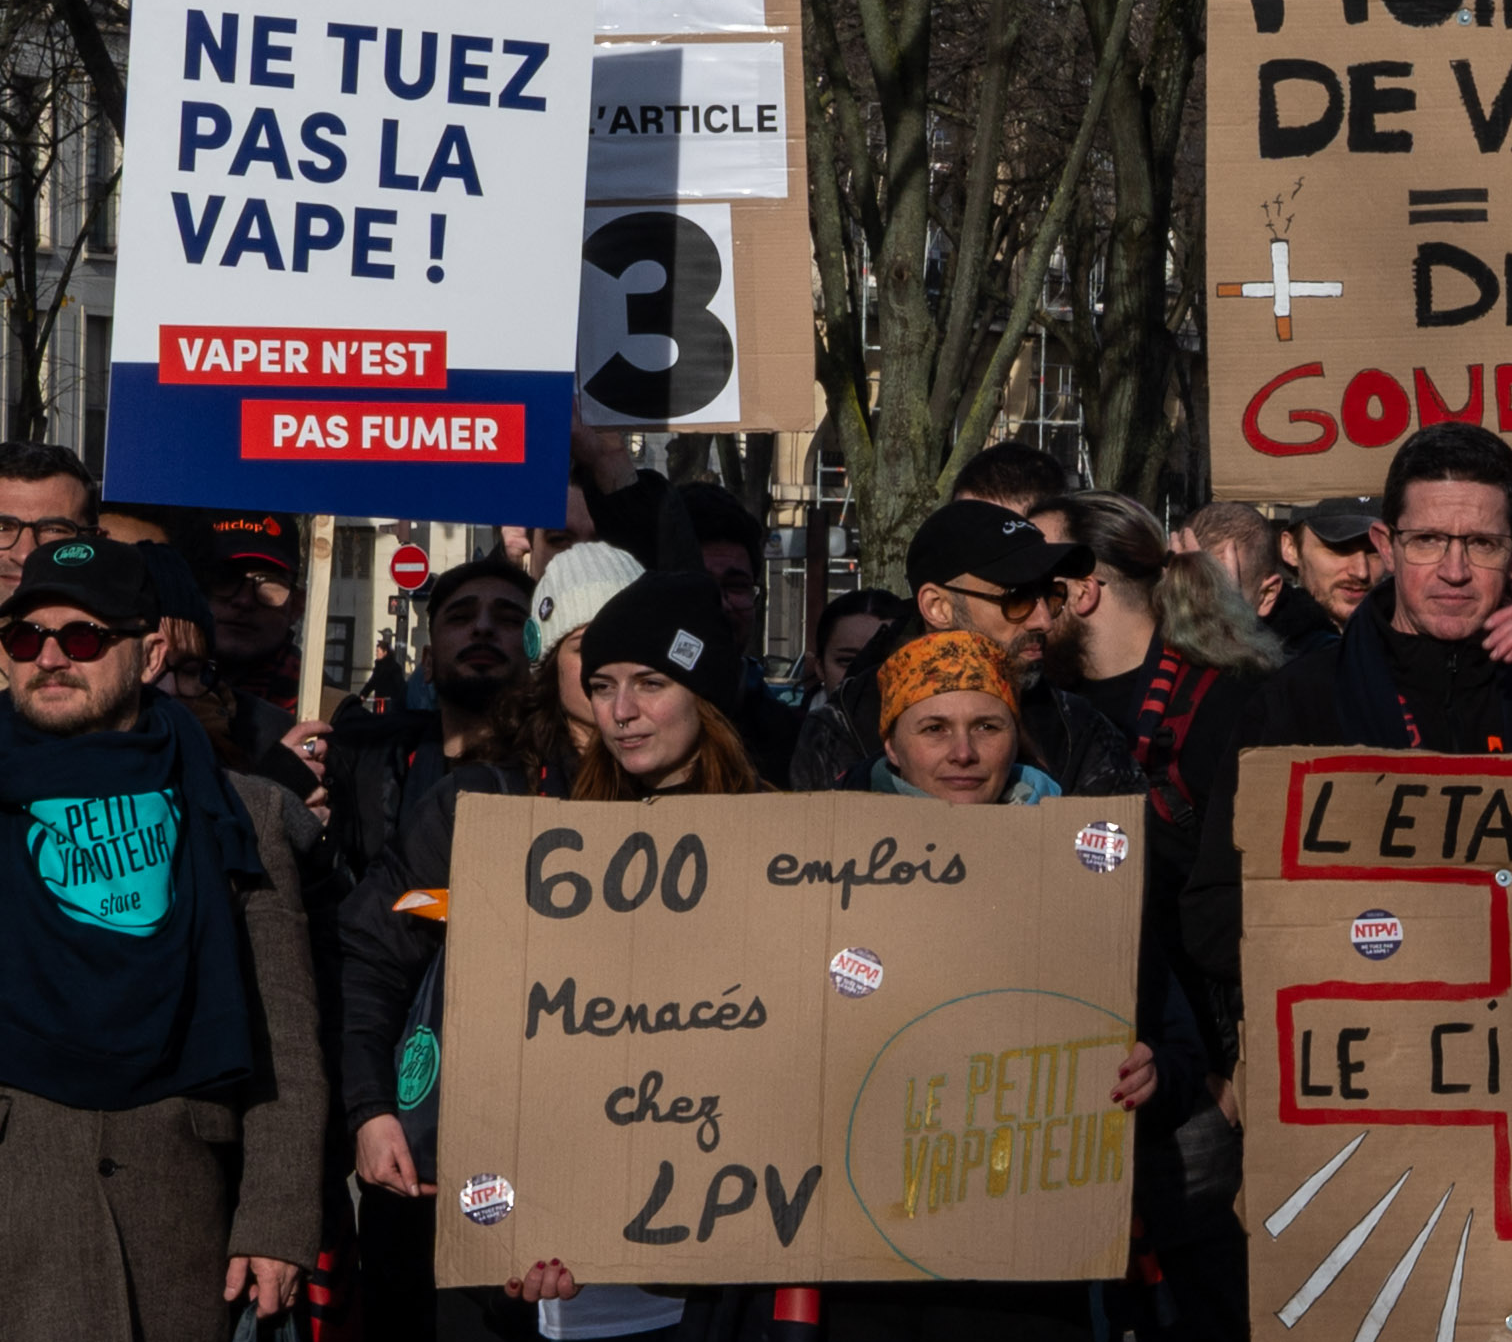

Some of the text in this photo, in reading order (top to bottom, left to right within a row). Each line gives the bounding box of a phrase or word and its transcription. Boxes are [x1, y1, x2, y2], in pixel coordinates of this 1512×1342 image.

[1258, 58, 1417, 160] DE
[99, 889, 141, 916] store
[524, 827, 967, 920] 600 emplois
[1354, 922, 1398, 937] NTPV!
[524, 977, 768, 1040] Menacés
[1300, 1027, 1371, 1101] LE
[604, 1070, 723, 1154] chez
[622, 1160, 824, 1248] LPV
